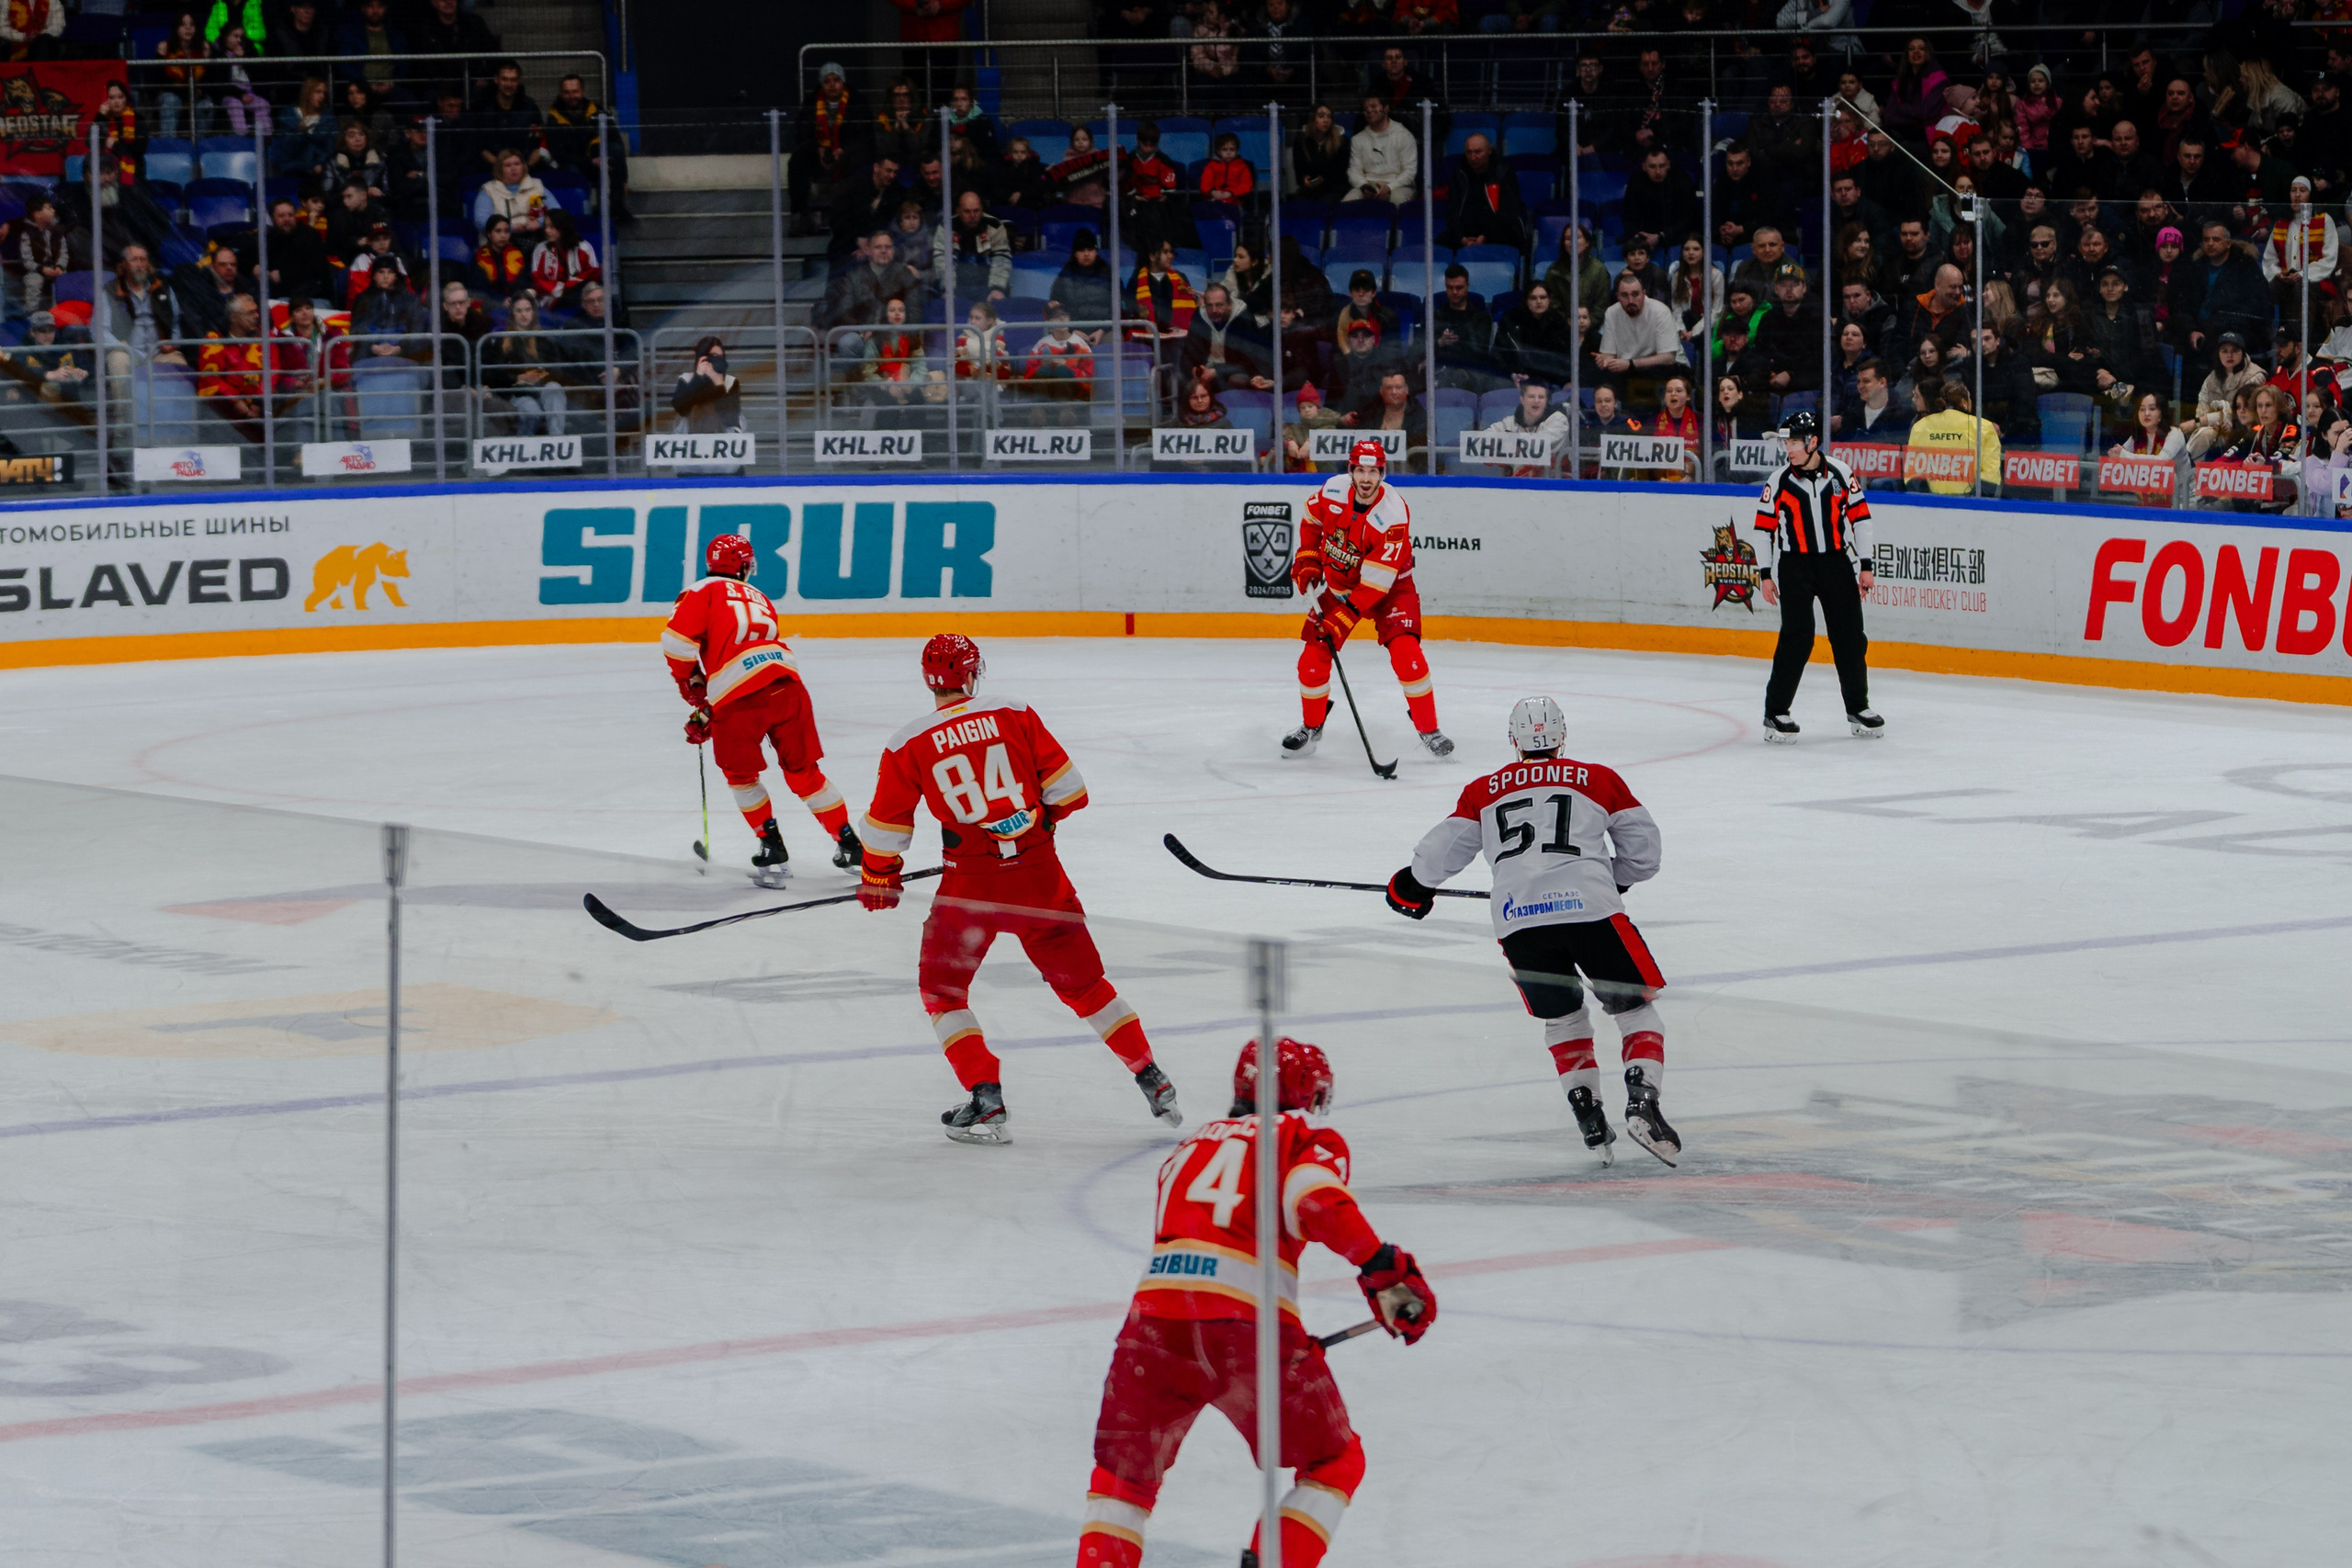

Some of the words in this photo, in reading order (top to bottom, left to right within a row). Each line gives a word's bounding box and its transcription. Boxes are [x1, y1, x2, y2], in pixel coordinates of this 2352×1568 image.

[0, 115, 79, 138] EDSTAR
[822, 435, 915, 457] KHL.RU
[992, 434, 1084, 456] KHL.RU
[1159, 434, 1248, 455] KHL.RU
[1465, 437, 1545, 459] KHL.RU
[1929, 433, 1962, 441] SAFETY
[480, 442, 574, 464] KHL.RU
[653, 439, 747, 460] KHL.RU
[1606, 439, 1679, 465] KHL.RU
[1735, 446, 1788, 466] KHL.R
[1905, 451, 1973, 477] FONBET
[2006, 457, 2079, 483] FONBET
[2099, 462, 2173, 491] FONBET
[2197, 468, 2272, 493] FONBET
[1247, 505, 1288, 515] FONBET
[206, 515, 289, 535] ШИНЫ
[539, 501, 996, 605] SIBUR
[1381, 542, 1403, 561] 27
[1410, 536, 1481, 551] АЛЬНАЯ
[1872, 543, 1985, 584] 星冰球俱乐部
[0, 558, 290, 612] SLAVED
[1702, 562, 1759, 589] REDSTAR
[1249, 586, 1291, 595] 2024/2025
[1871, 585, 1888, 606] RED
[1893, 586, 1917, 608] STAR
[1920, 589, 1958, 611] HOCKEY
[1962, 591, 1986, 613] CLUB
[2084, 537, 2352, 658] FONB
[727, 599, 778, 645] 15
[742, 651, 784, 671] SIBUR
[931, 715, 1000, 753] PAIGIN
[1533, 735, 1548, 748] 51
[932, 742, 1027, 824] 84
[1488, 765, 1589, 795] SPOONER
[1495, 794, 1581, 864] 51
[1513, 899, 1583, 918] ГАЗПРОМНЕФТЬ
[1157, 1138, 1249, 1235] 74
[1149, 1254, 1218, 1277] SIBUR
